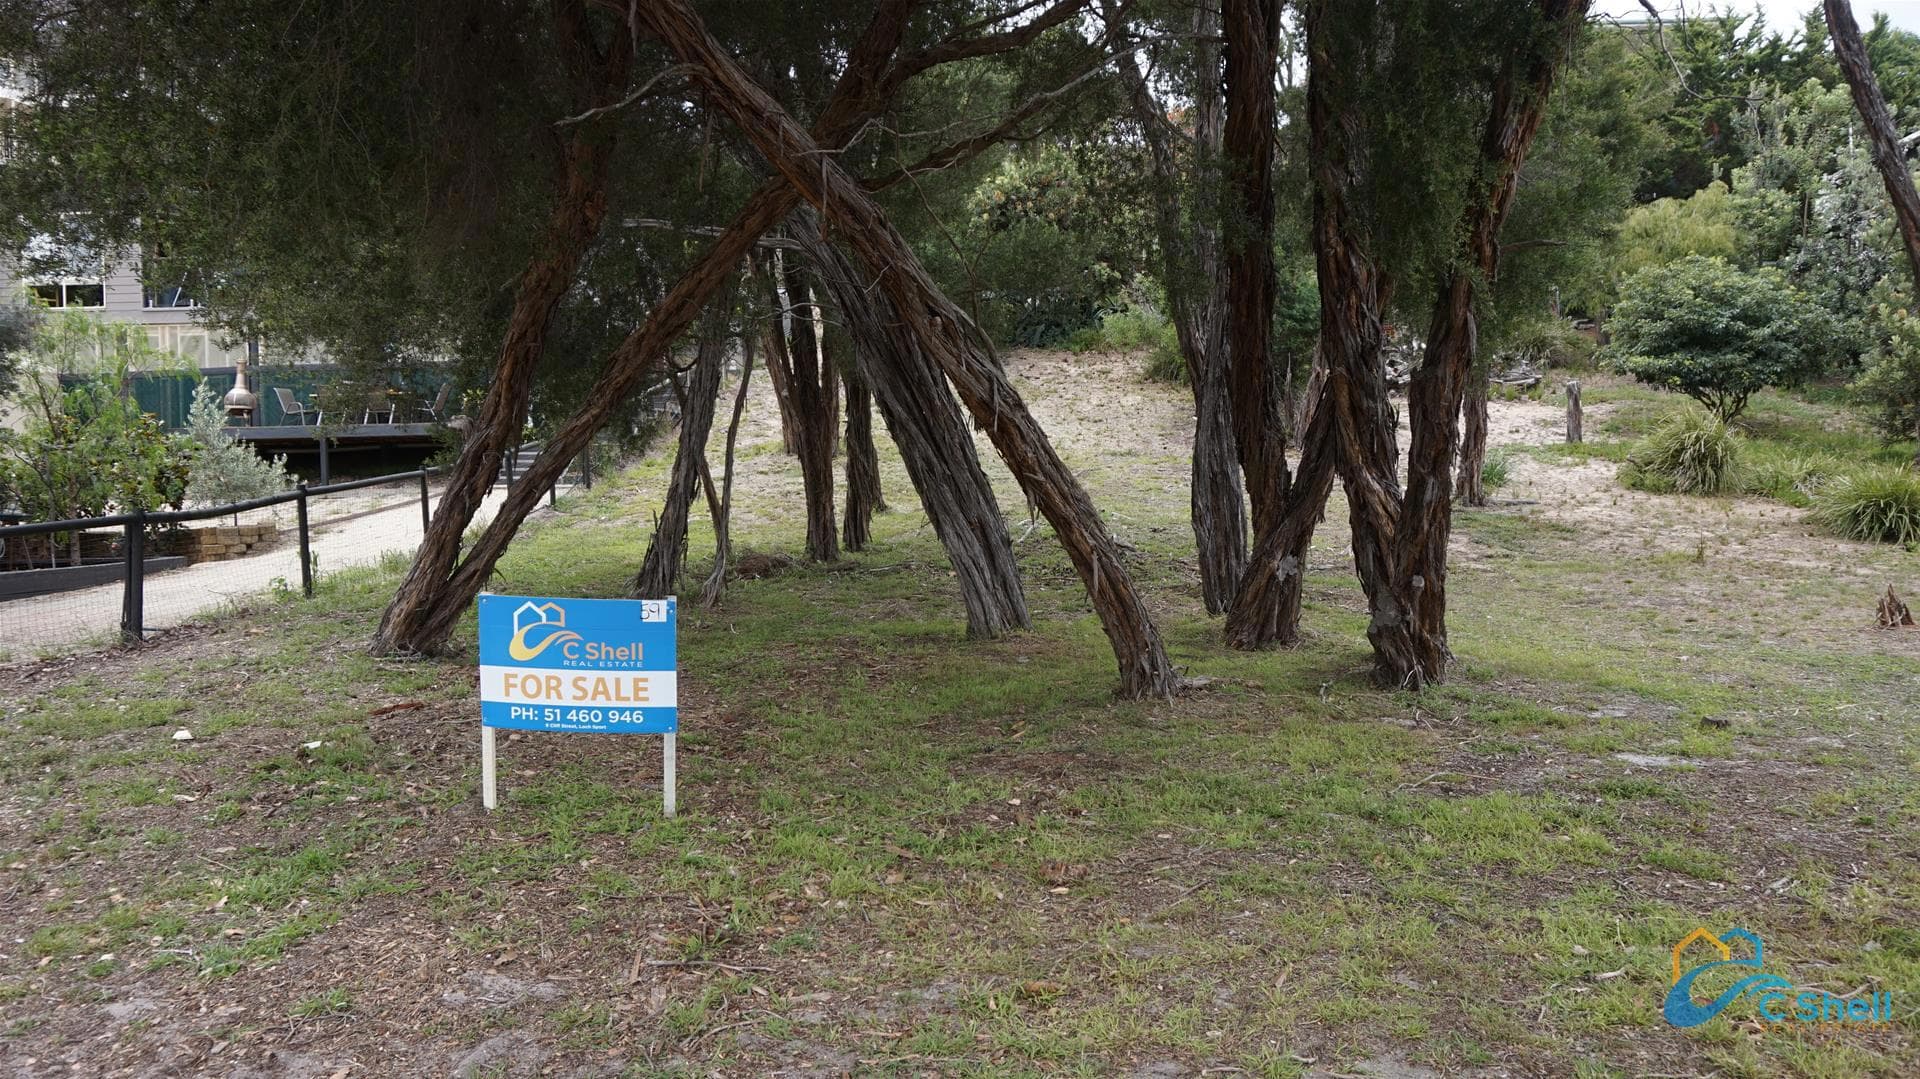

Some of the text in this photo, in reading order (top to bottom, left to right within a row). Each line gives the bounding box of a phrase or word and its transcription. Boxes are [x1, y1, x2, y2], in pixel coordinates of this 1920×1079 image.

[640, 603, 660, 620] 59
[563, 641, 643, 660] C Shell
[504, 673, 650, 702] FOR SALE
[511, 707, 643, 723] PH: 51 460 946
